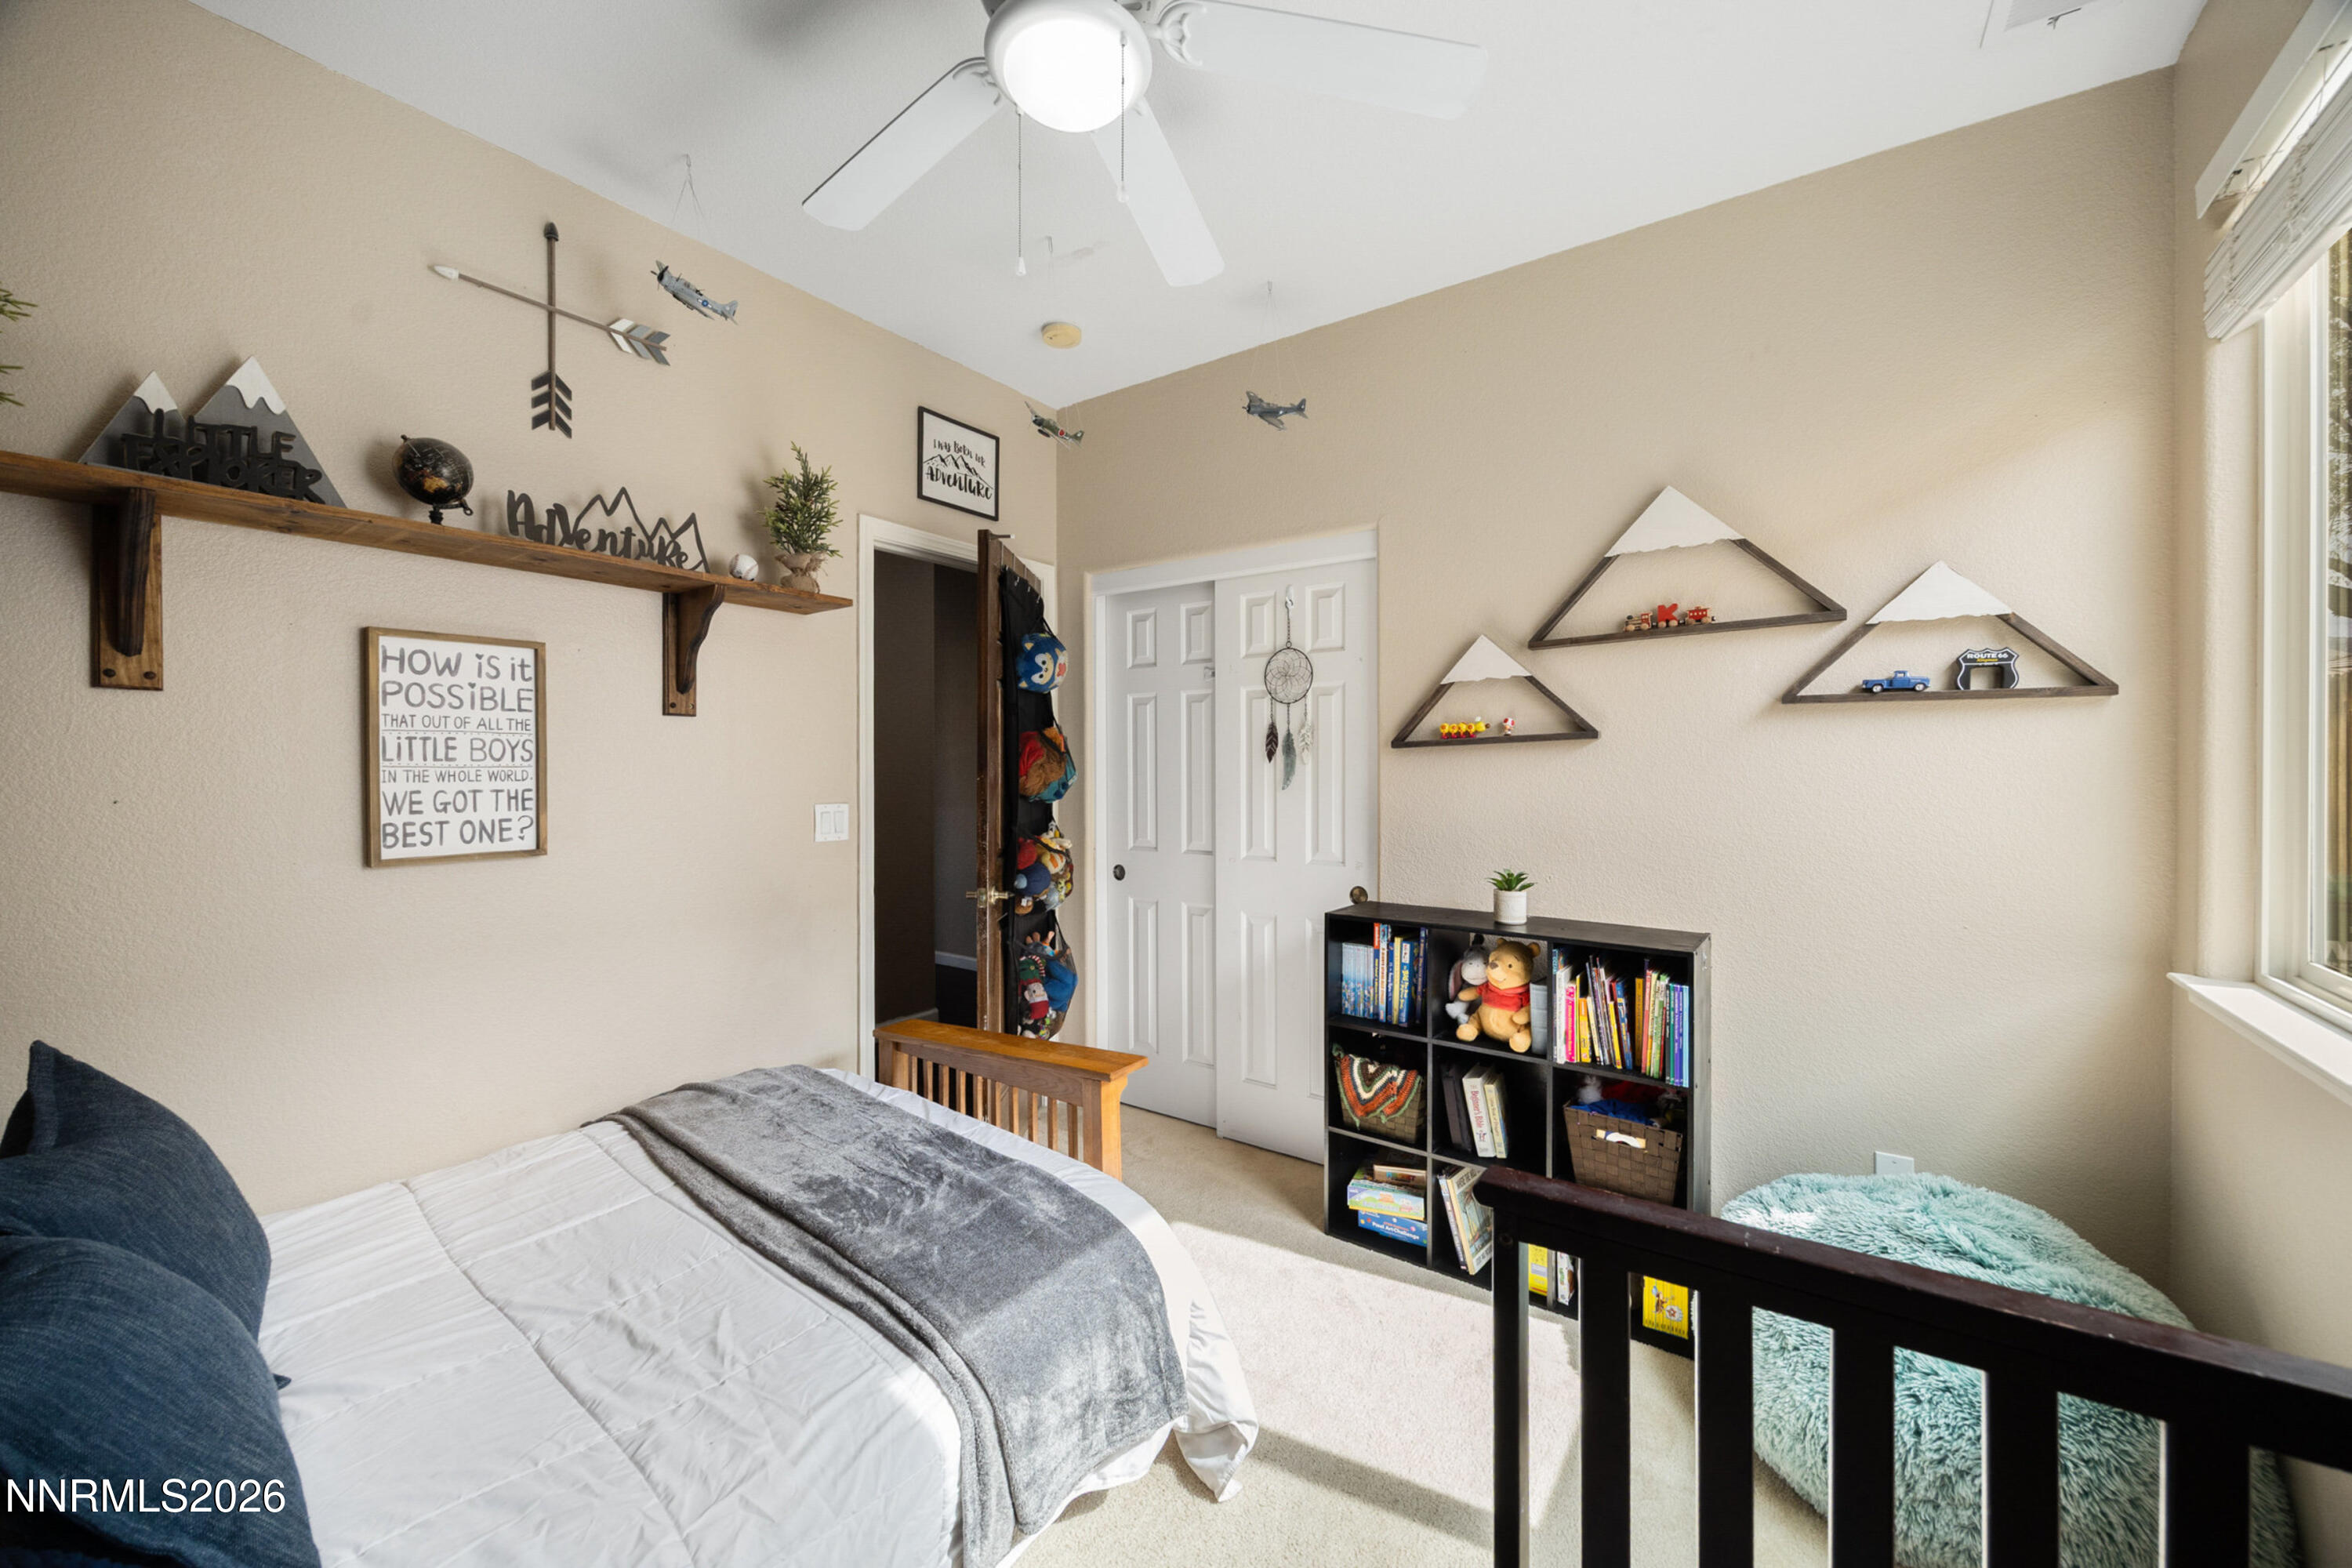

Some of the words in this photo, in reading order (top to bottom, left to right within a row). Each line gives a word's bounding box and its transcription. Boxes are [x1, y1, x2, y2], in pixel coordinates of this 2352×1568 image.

[381, 645, 462, 677] HOW
[381, 713, 416, 728] THAT
[422, 715, 451, 729] OUT
[454, 717, 470, 730] OF
[477, 717, 503, 731] ALL
[506, 718, 531, 731] THE
[470, 738, 534, 763] BOYS
[382, 770, 397, 783] IN
[403, 770, 430, 783] THE
[434, 770, 482, 782] WHOLE
[488, 769, 533, 782] WORLD.
[382, 789, 424, 816] WE
[433, 789, 484, 814] GOT
[490, 788, 533, 812] THE
[382, 820, 451, 849] BEST
[459, 815, 534, 845] ONE?
